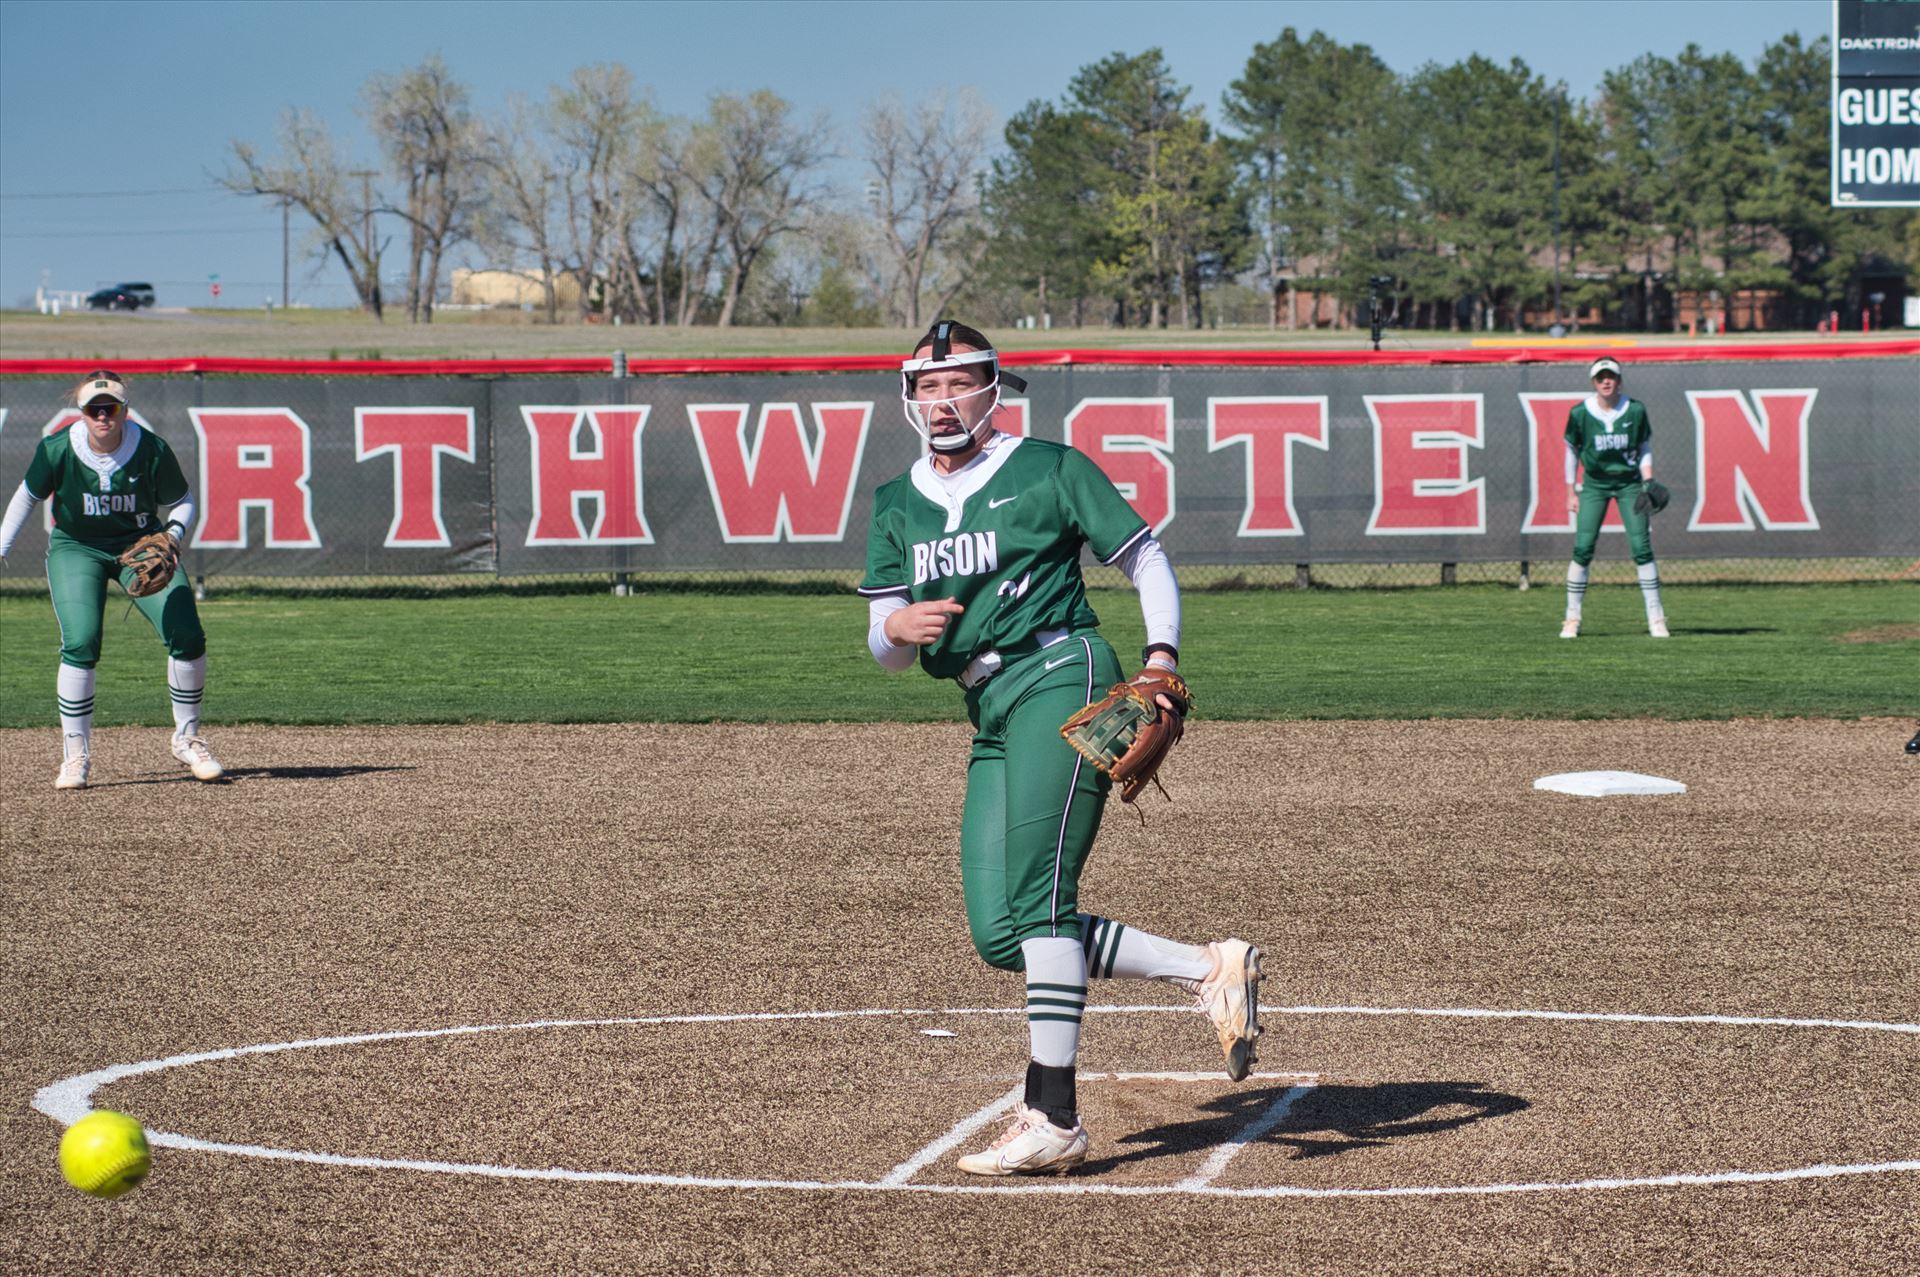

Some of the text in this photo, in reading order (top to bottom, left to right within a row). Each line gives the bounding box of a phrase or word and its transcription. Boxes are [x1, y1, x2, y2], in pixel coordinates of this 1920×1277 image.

[1594, 433, 1629, 451] BISON
[83, 493, 136, 516] BISON
[912, 531, 998, 586] BISON
